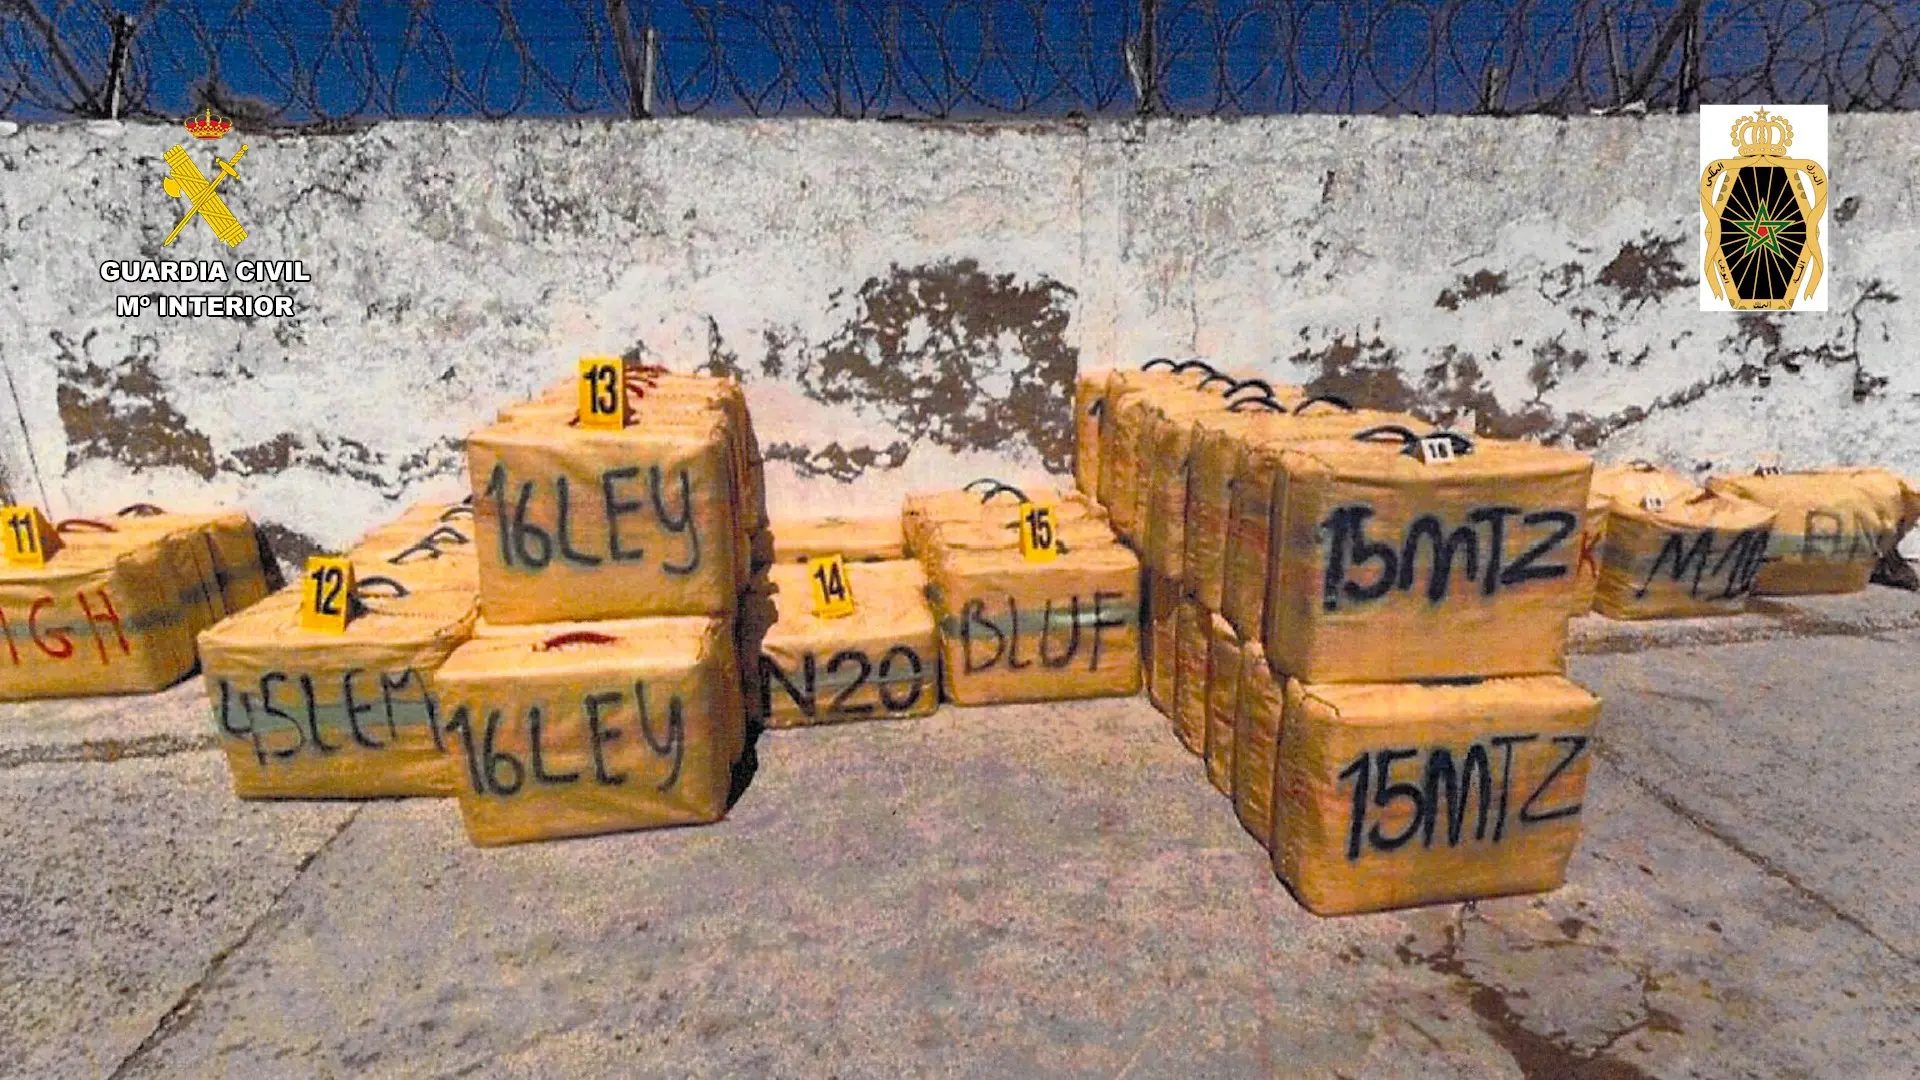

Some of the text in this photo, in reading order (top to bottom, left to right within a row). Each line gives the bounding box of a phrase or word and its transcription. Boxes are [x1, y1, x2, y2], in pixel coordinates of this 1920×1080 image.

[582, 364, 618, 415] 13
[8, 514, 37, 553] 11
[1025, 507, 1052, 550] 15
[1322, 505, 1580, 611] 15MTZ
[311, 566, 345, 616] 12
[813, 562, 847, 605] 14
[962, 591, 1124, 674] BLUF
[1338, 735, 1589, 861] 15MTZ
